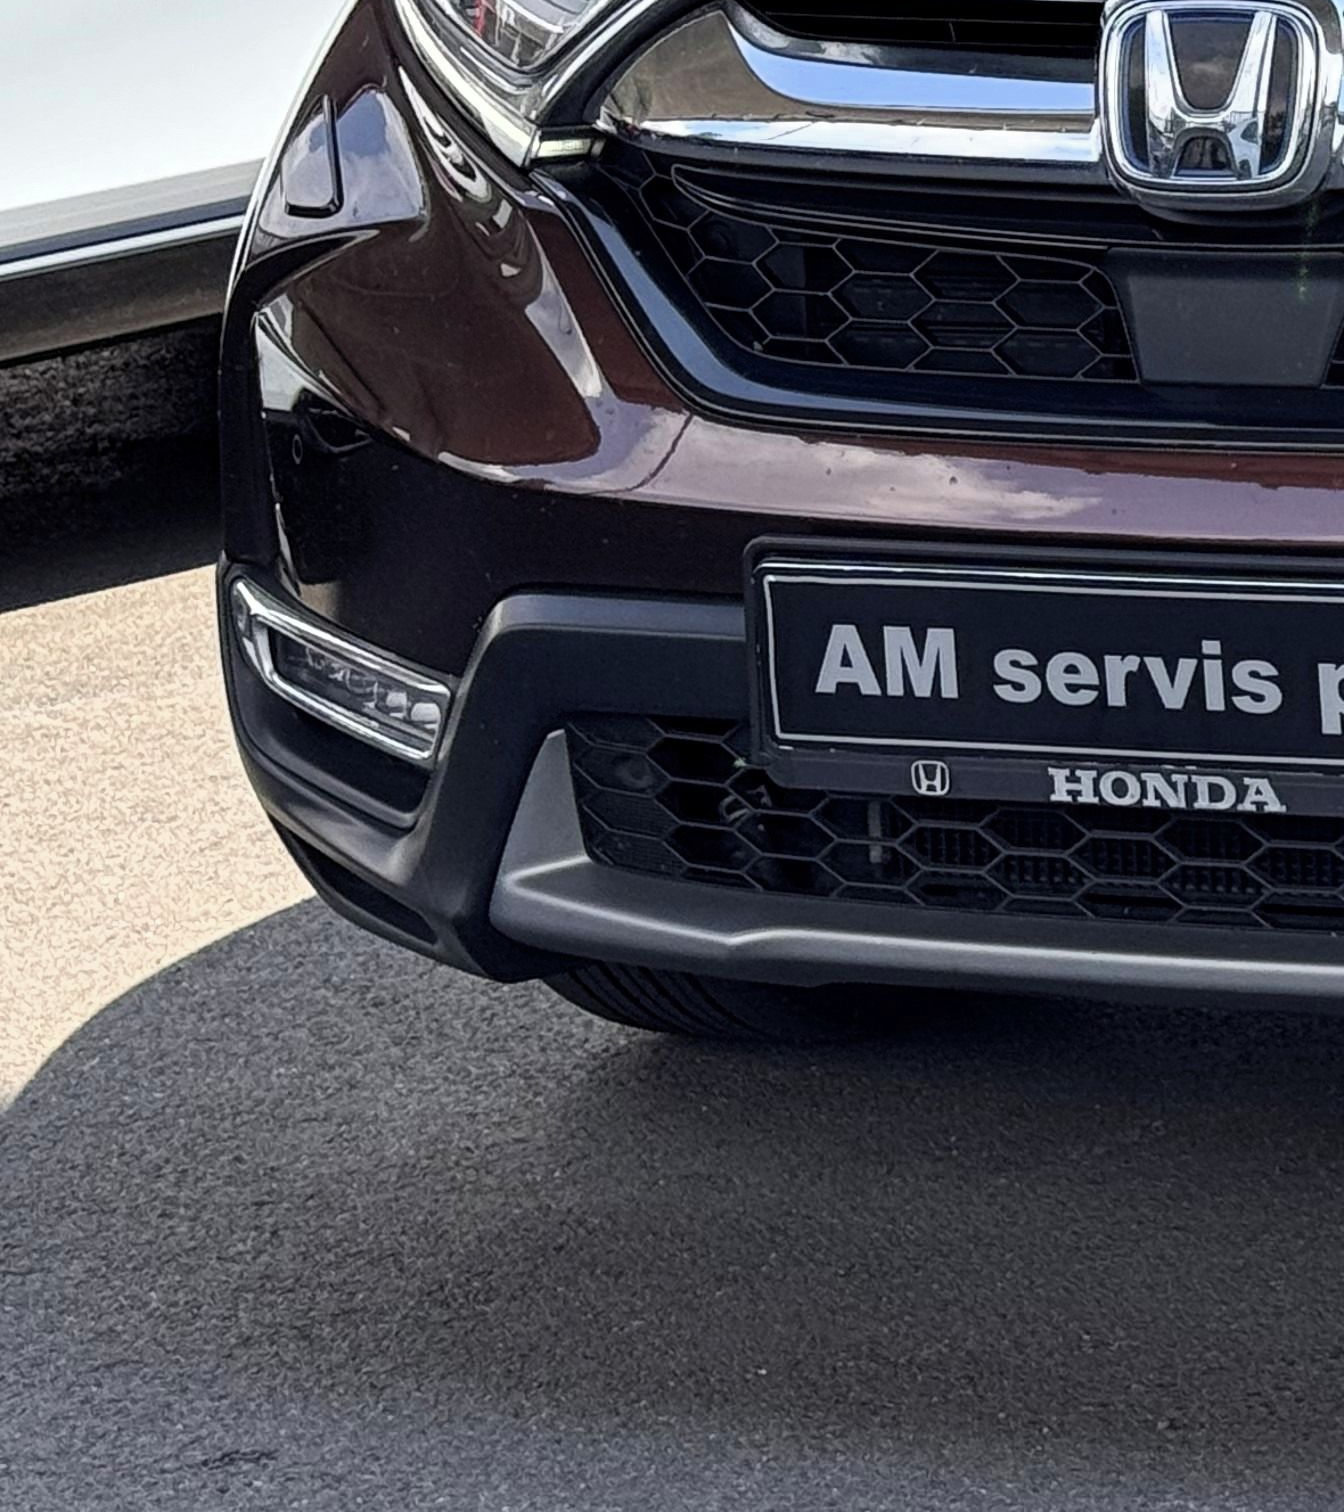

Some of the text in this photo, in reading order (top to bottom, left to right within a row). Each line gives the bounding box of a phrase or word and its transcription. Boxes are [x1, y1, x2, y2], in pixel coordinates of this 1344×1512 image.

[814, 624, 959, 700] AM
[992, 639, 1283, 715] servis
[1047, 767, 1287, 813] HONDA
